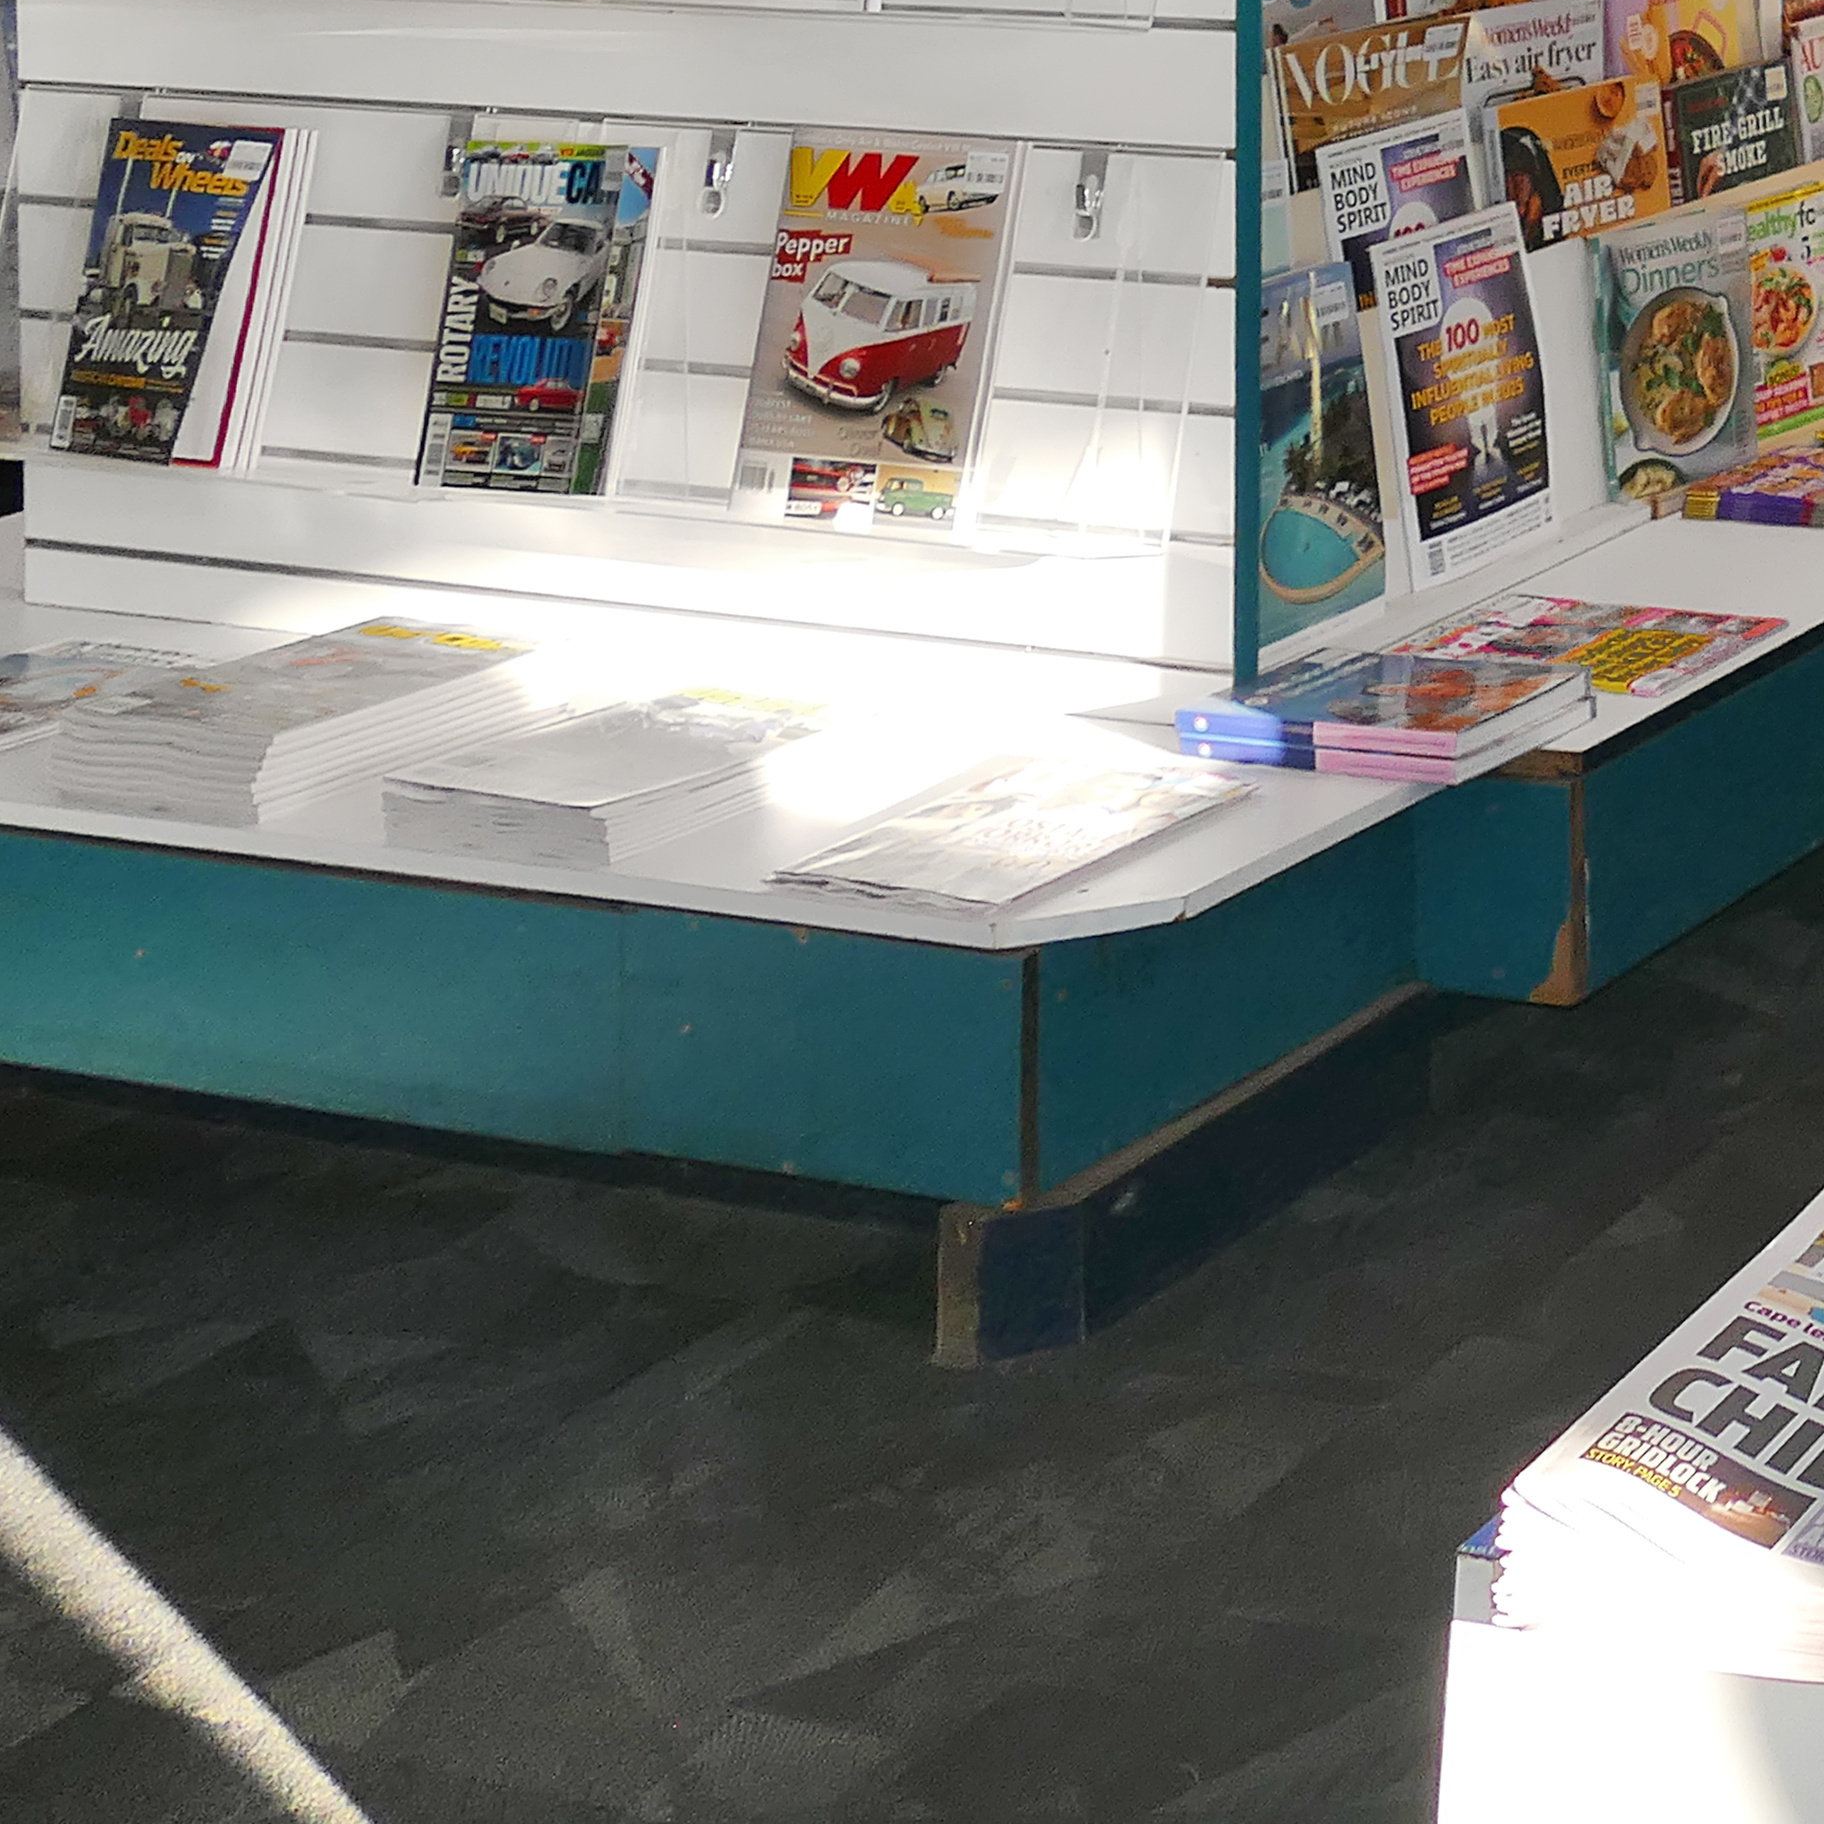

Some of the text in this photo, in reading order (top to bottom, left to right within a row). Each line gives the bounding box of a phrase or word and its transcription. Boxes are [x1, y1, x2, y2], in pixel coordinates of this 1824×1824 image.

[112, 129, 181, 164] Deals
[1715, 144, 1768, 177] SMOKE
[149, 160, 252, 200] Wheels
[466, 161, 572, 204] UNIQUE
[776, 231, 850, 262] Pepper
[1383, 258, 1429, 288] MIND
[1387, 279, 1431, 310] BODY
[436, 275, 481, 383] ROTARY
[1389, 298, 1440, 331] SPIRIT
[73, 315, 198, 384] Amazing
